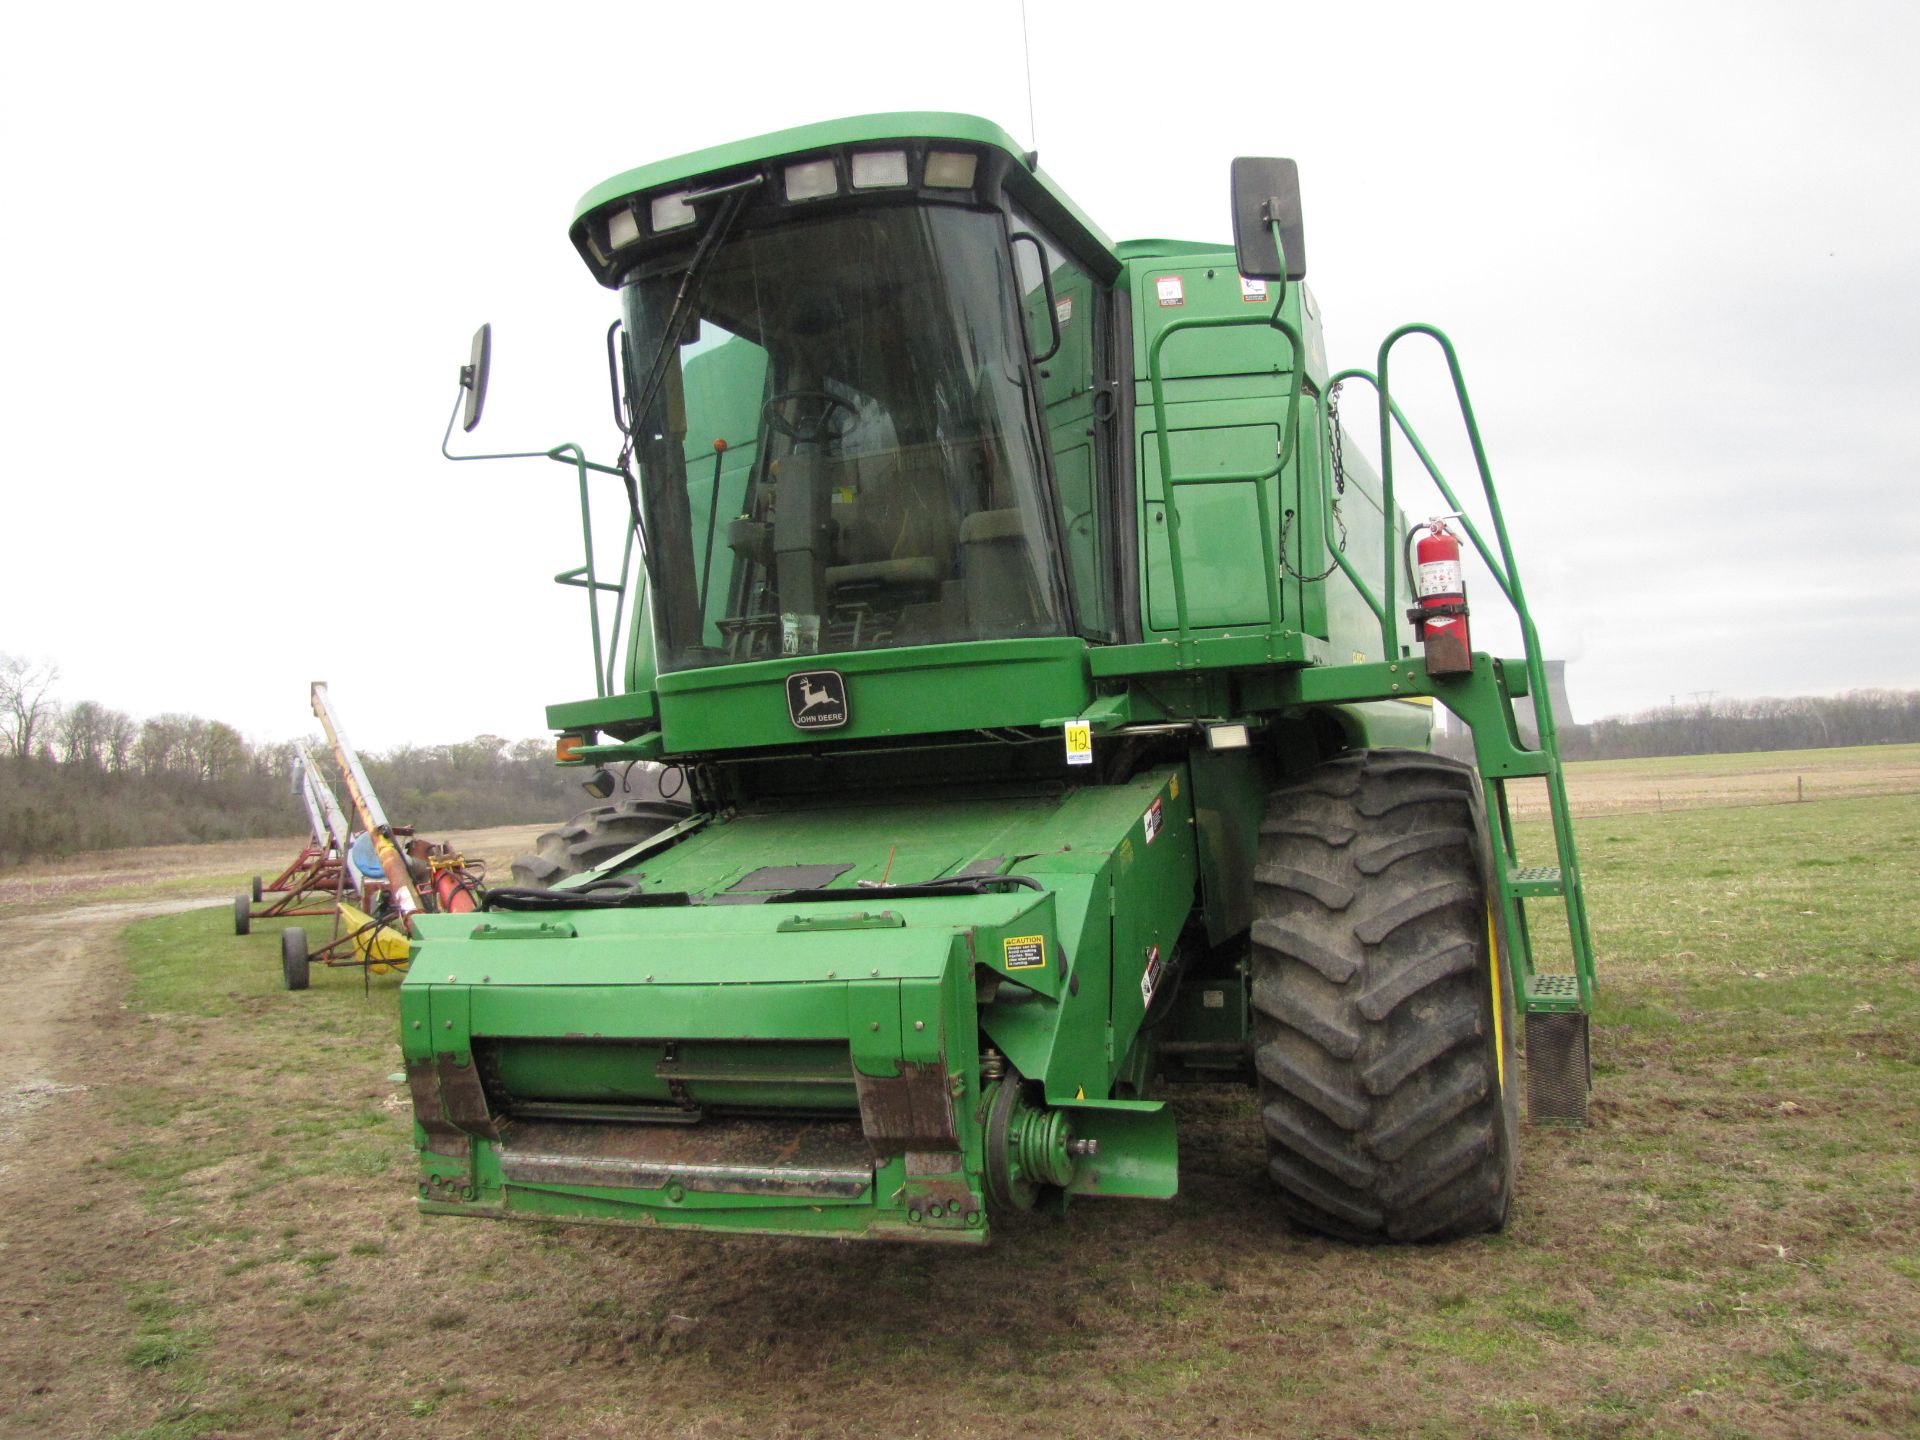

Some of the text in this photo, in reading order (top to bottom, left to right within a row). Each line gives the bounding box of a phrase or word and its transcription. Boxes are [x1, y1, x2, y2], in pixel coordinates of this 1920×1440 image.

[797, 713, 843, 723] JOHN DEERE
[1069, 729, 1091, 751] 42
[1011, 936, 1041, 944] CAUTION
